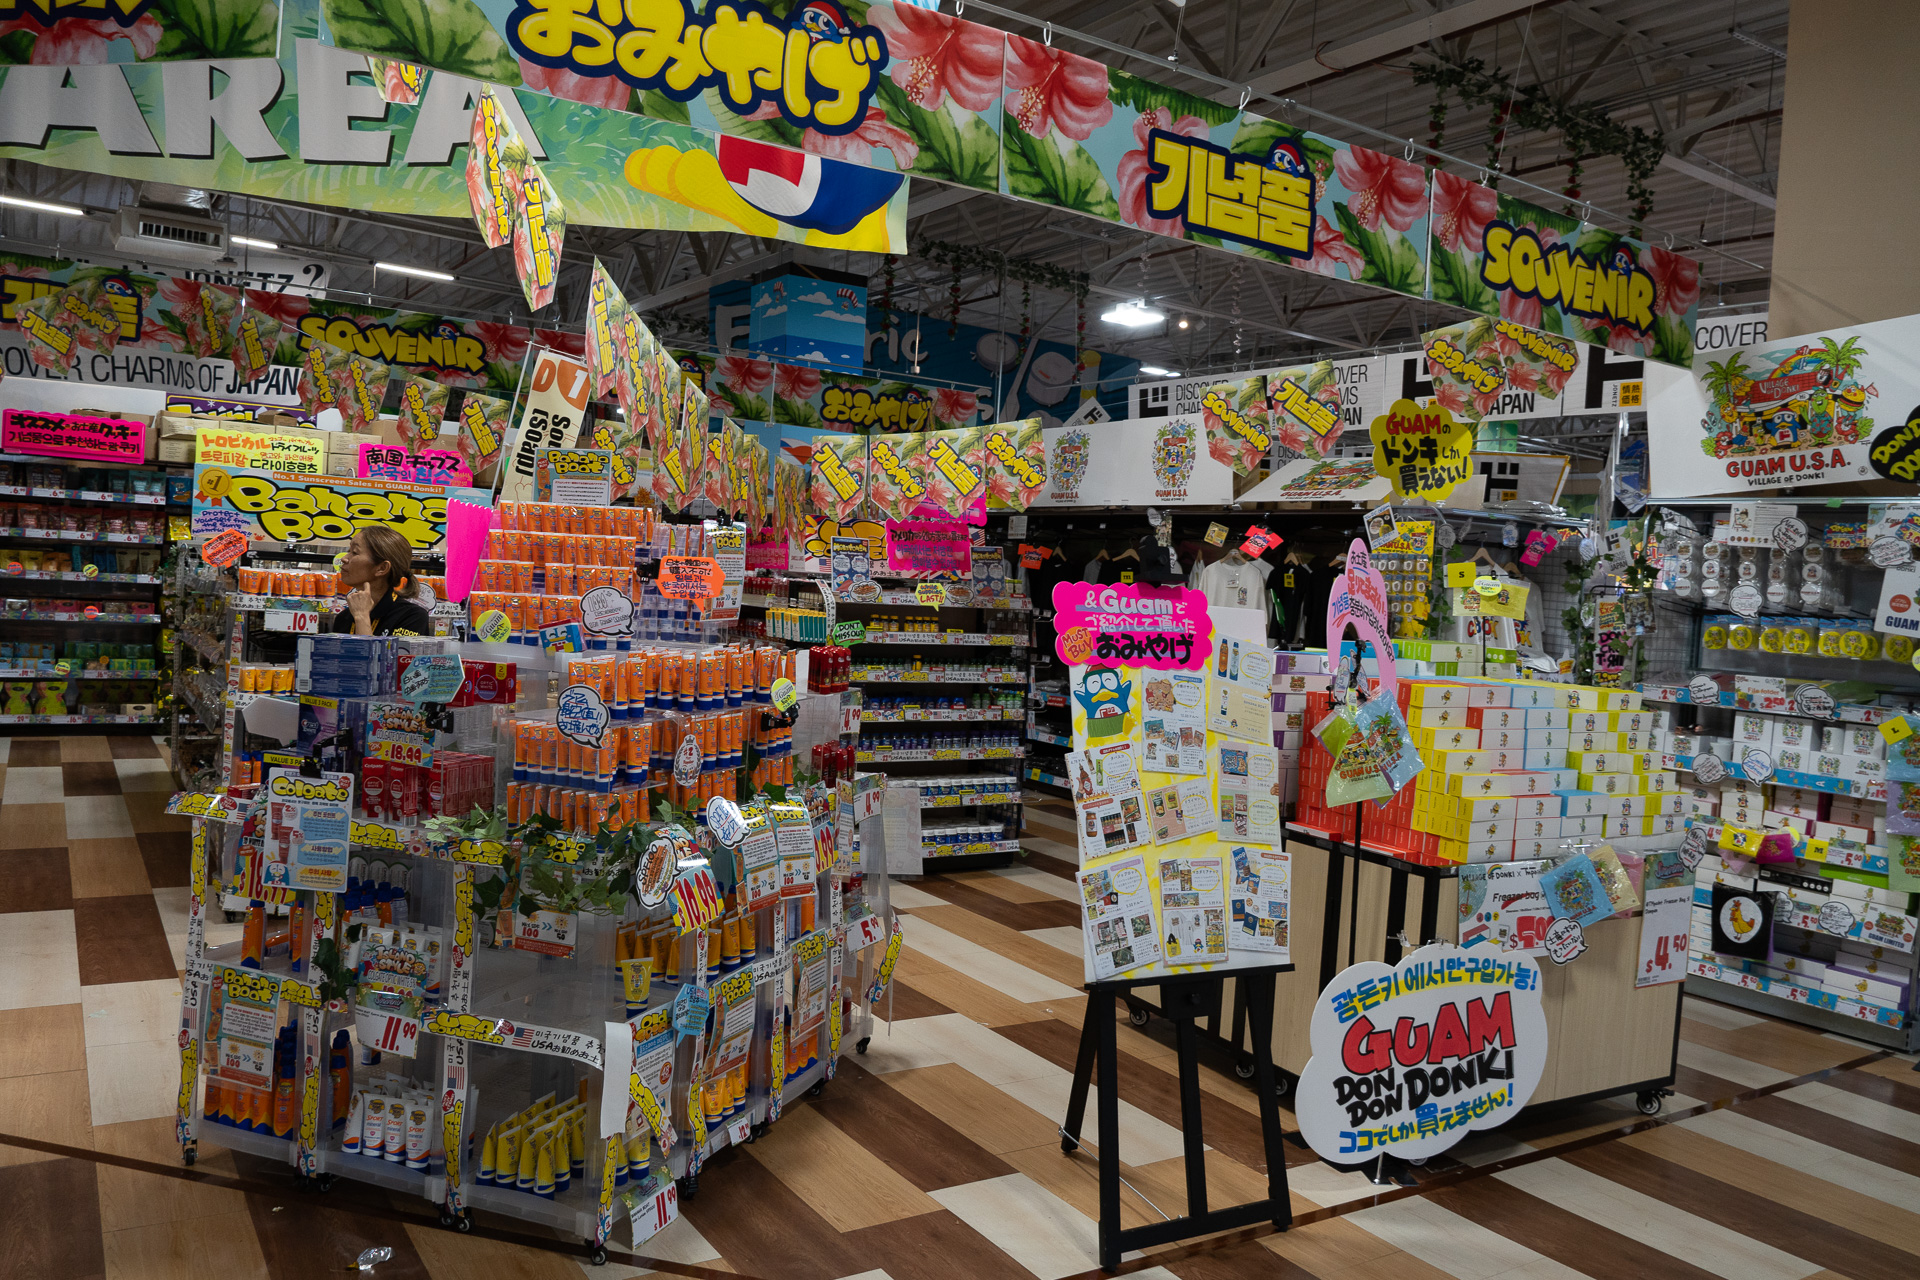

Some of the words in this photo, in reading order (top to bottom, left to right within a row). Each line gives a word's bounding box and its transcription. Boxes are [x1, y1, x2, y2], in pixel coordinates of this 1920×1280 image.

[516, 0, 880, 127] おみやげ
[1152, 135, 1312, 254] 기념품
[523, 177, 553, 291] 기념품
[1483, 225, 1655, 334] SOUVENIR
[299, 315, 485, 374] SOUVENIR
[91, 354, 195, 391] CHARMS
[199, 364, 224, 392] OF
[1427, 340, 1505, 393] おみやげ
[822, 385, 932, 432] おみやげ
[1274, 378, 1341, 437] 기념품
[1758, 378, 1790, 396] VILLAGE
[1774, 385, 1800, 399] DONKI
[201, 434, 271, 450] トロピカル
[1201, 392, 1271, 452] SOUVENIR
[813, 442, 861, 502] 기념품
[871, 441, 926, 499] おみやげ
[927, 437, 982, 497] 기념품
[985, 432, 1047, 488] おみやげ
[1380, 435, 1460, 467] ドンキしか
[1725, 458, 1786, 478] GUAM
[1790, 449, 1852, 471] U.S.A.
[348, 478, 371, 488] Sales
[386, 482, 411, 491] GUAM
[1398, 456, 1468, 495] 買えない!
[1748, 476, 1783, 487] VILLAGE
[229, 475, 448, 523] Banana
[1832, 539, 1851, 549] 3.00
[1095, 632, 1195, 666] おみやげ
[384, 743, 423, 763] $18.99
[271, 775, 350, 802] Colgate
[376, 947, 417, 964] ISLAND
[223, 967, 280, 994] Banana
[228, 983, 274, 1004] Boat
[375, 1016, 418, 1052] $11.99
[436, 1011, 497, 1035] USA
[1341, 990, 1518, 1076] GUAM
[1332, 1067, 1396, 1106] DON
[1402, 1046, 1515, 1111] DONKI
[1338, 1083, 1514, 1154] ココでしか買えません!
[1345, 1082, 1404, 1129] DON
